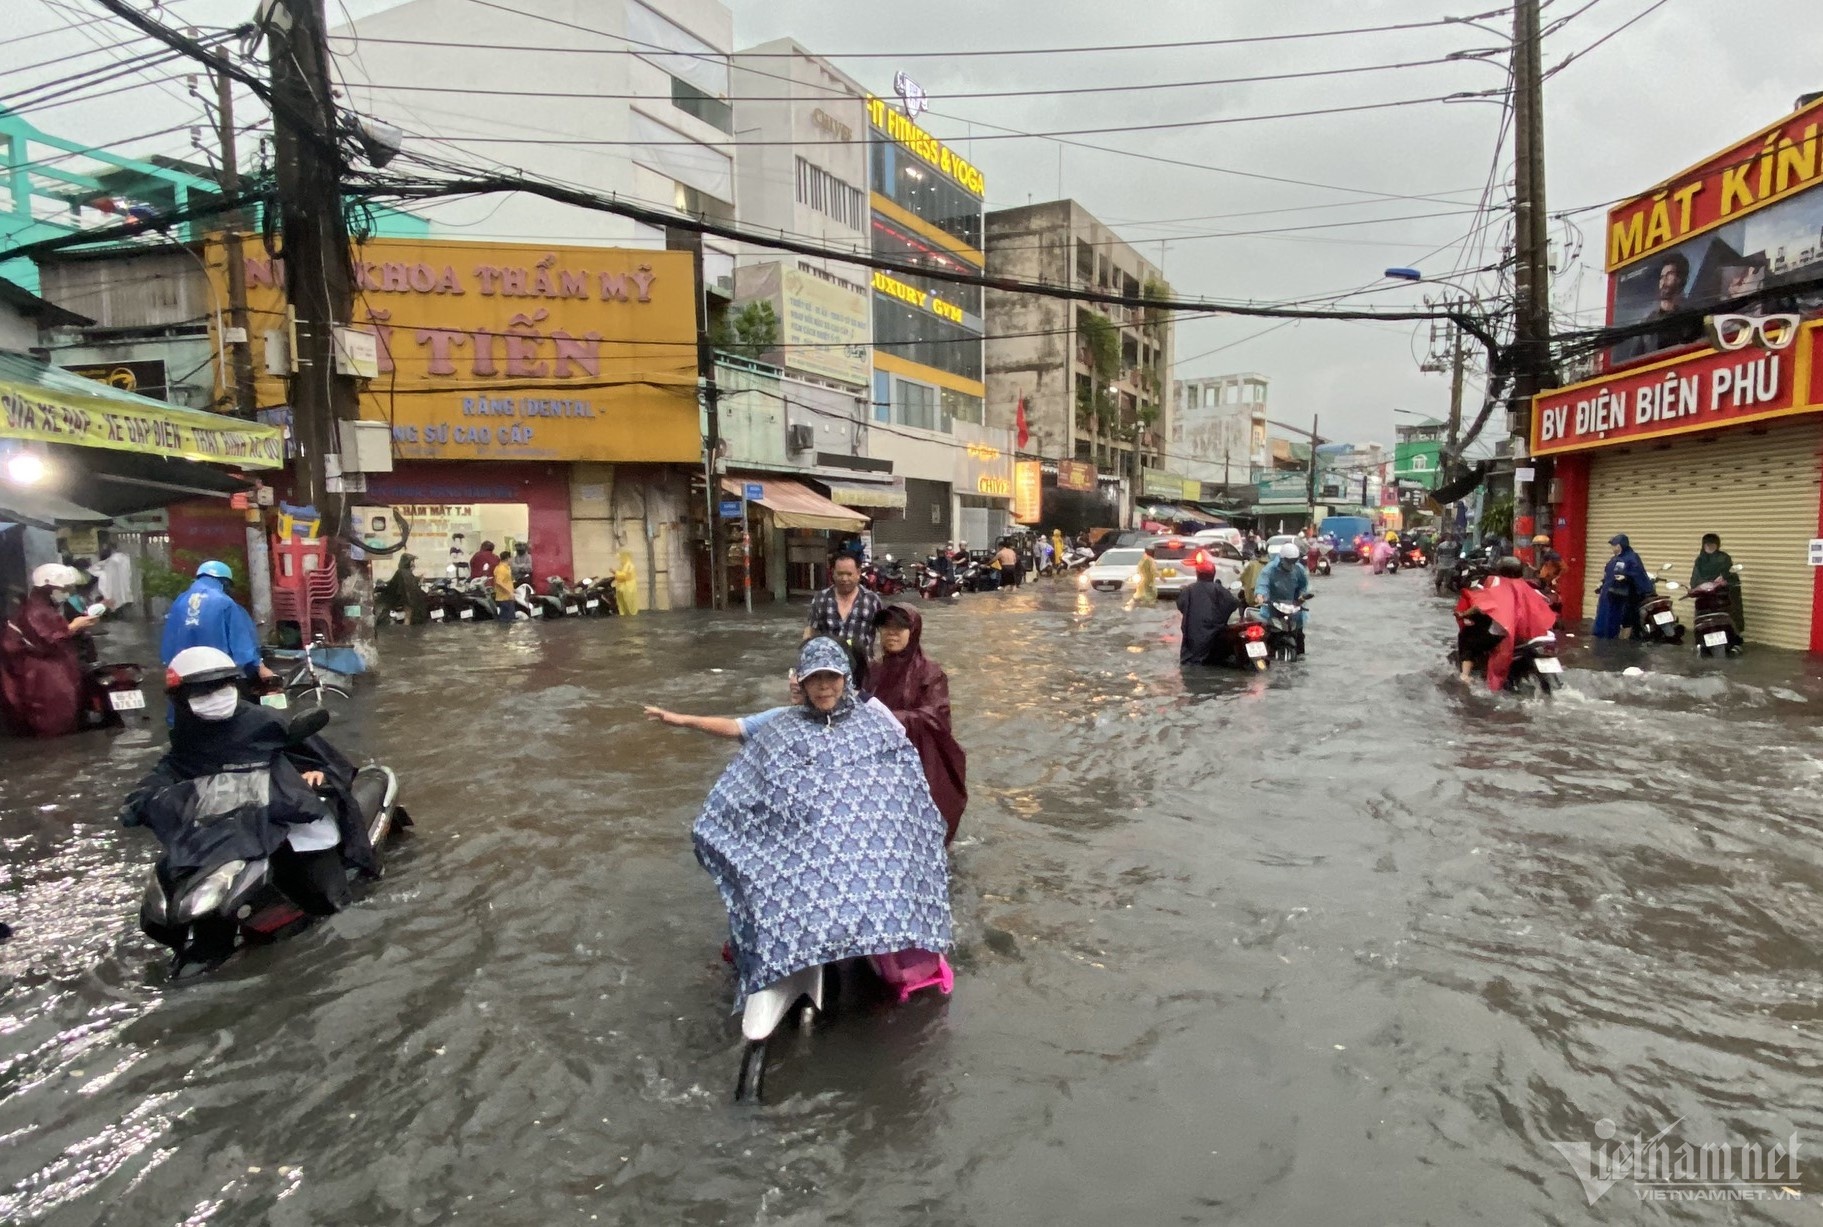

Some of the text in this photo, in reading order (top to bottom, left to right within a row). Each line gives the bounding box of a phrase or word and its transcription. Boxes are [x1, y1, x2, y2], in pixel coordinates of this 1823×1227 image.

[888, 107, 938, 165] FITNESS
[940, 147, 951, 173] &
[951, 153, 985, 197] YOGA
[1610, 122, 1823, 266] MẮT KÍN
[356, 253, 657, 302] KHOA THẨM MỸ
[932, 298, 963, 323] GYM
[416, 307, 602, 379] TIẾN
[102, 413, 125, 441] XE
[463, 395, 515, 417] RĂNG
[1541, 404, 1568, 441] BV
[1575, 388, 1626, 439] ĐIỆN
[1635, 372, 1699, 424] BIÊN
[423, 421, 449, 445] SỨ
[453, 425, 492, 445] CAO
[498, 421, 535, 446] CẤP
